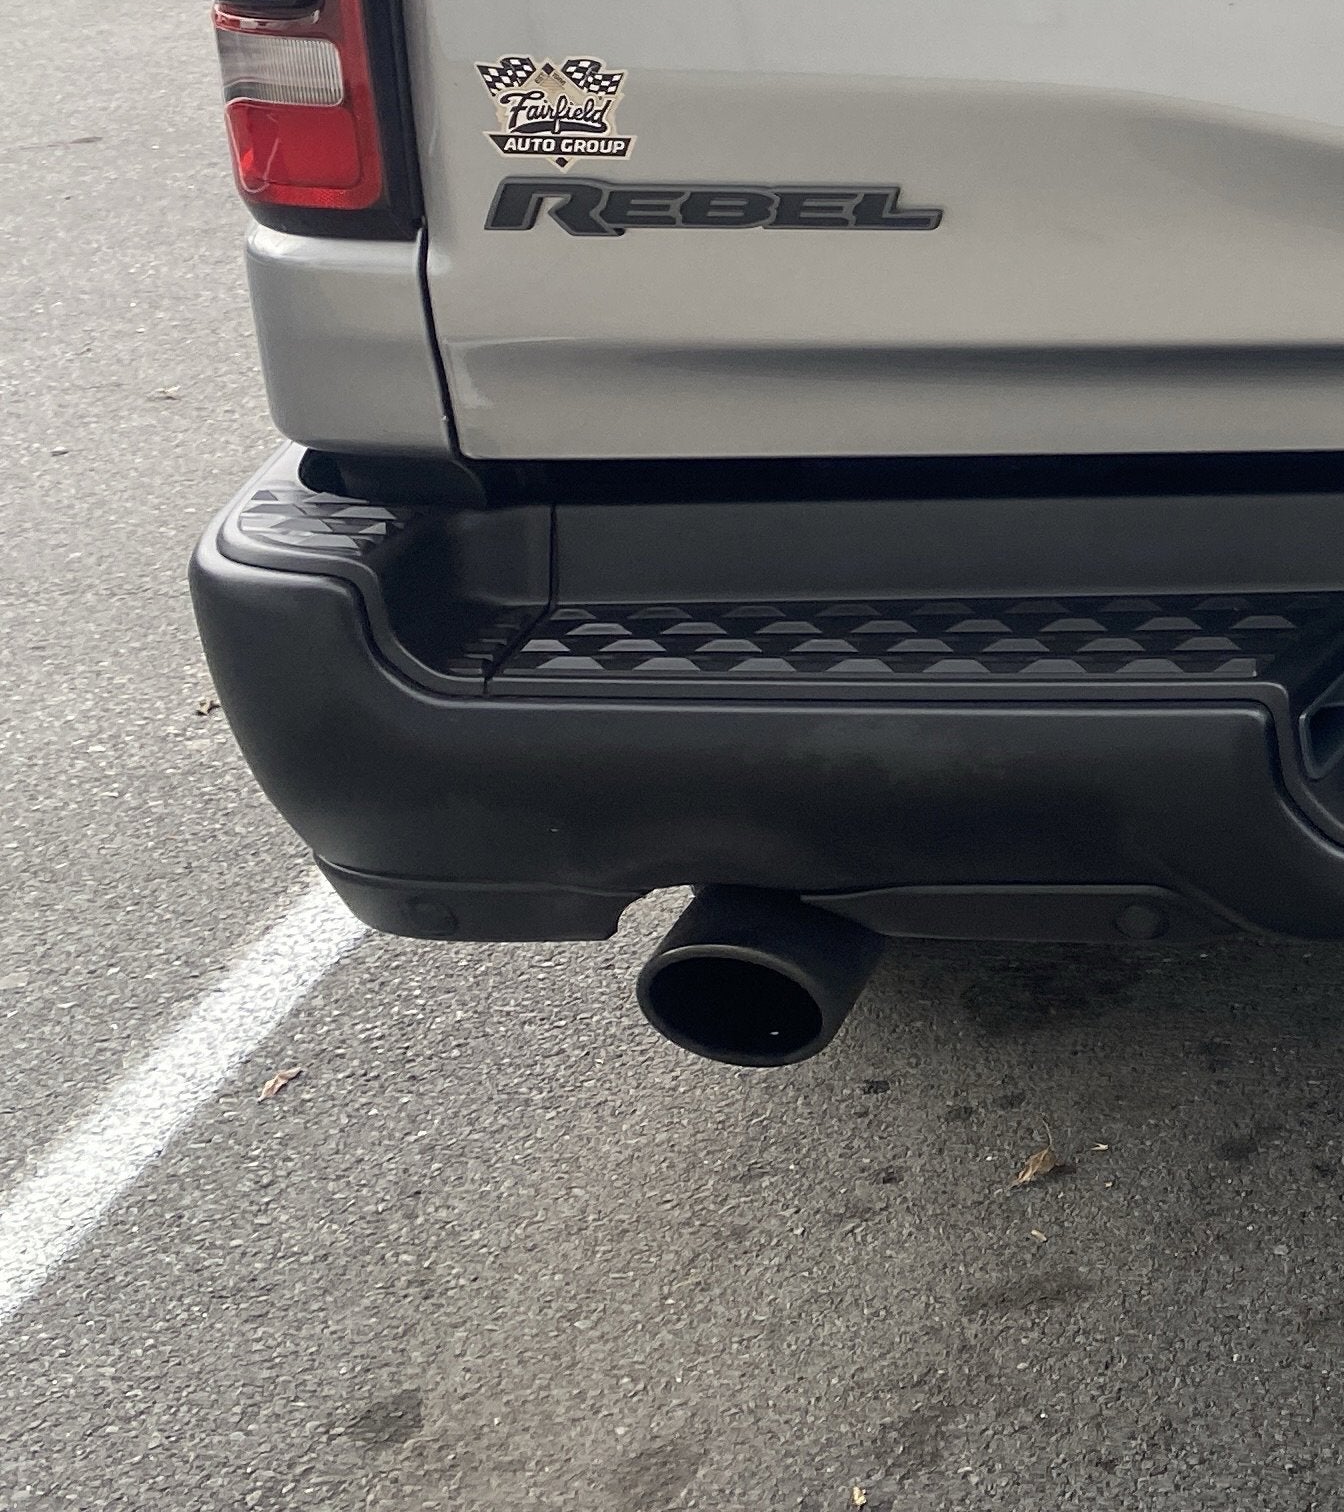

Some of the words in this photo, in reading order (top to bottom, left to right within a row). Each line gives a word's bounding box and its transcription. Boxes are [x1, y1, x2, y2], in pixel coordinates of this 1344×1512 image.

[500, 90, 612, 133] Fairfield
[504, 138, 555, 152] AUTO
[560, 139, 625, 154] GROUP
[484, 176, 943, 236] REBEL
